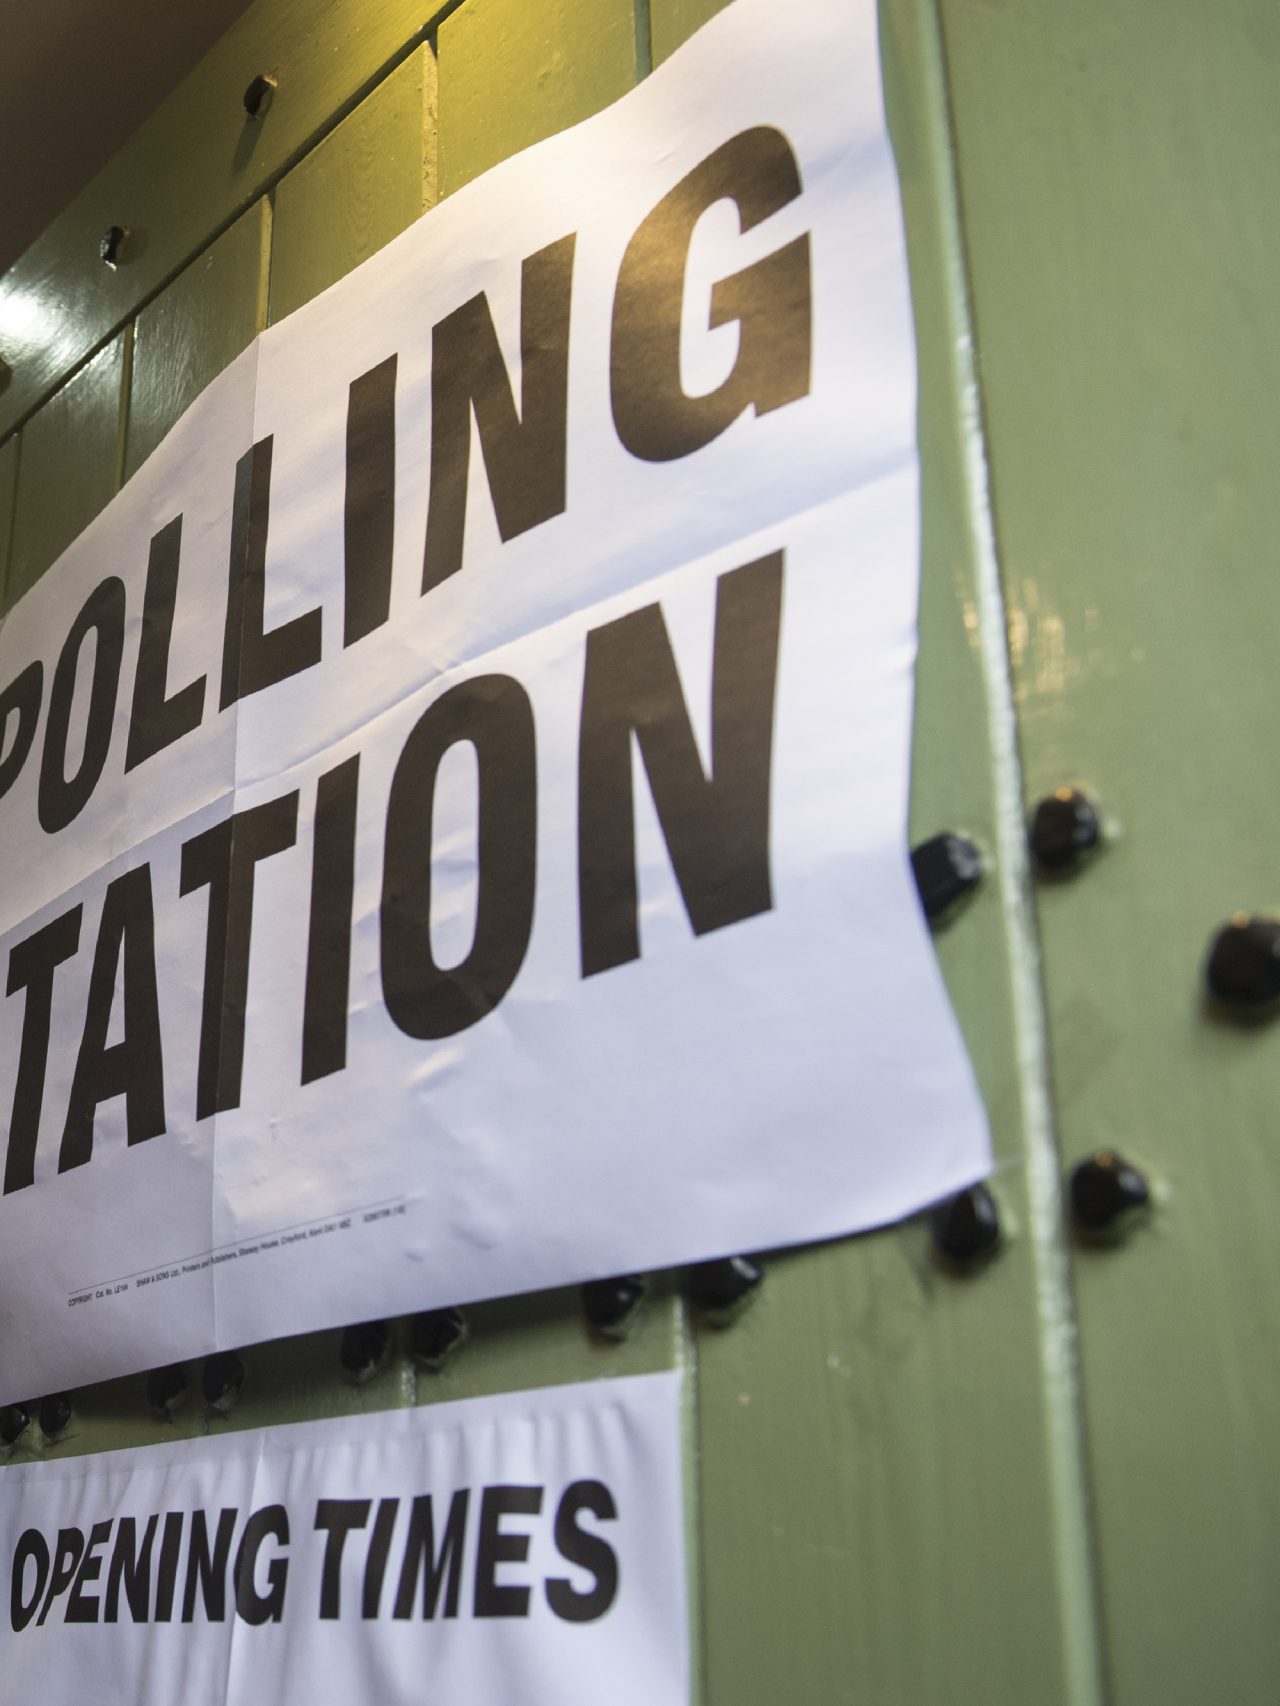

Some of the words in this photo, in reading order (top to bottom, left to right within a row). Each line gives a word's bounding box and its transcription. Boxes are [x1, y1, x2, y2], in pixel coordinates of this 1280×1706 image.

[68, 1294, 93, 1307] COPYRIGHT
[10, 1503, 291, 1633] OPENING
[312, 1479, 619, 1624] TIMES
